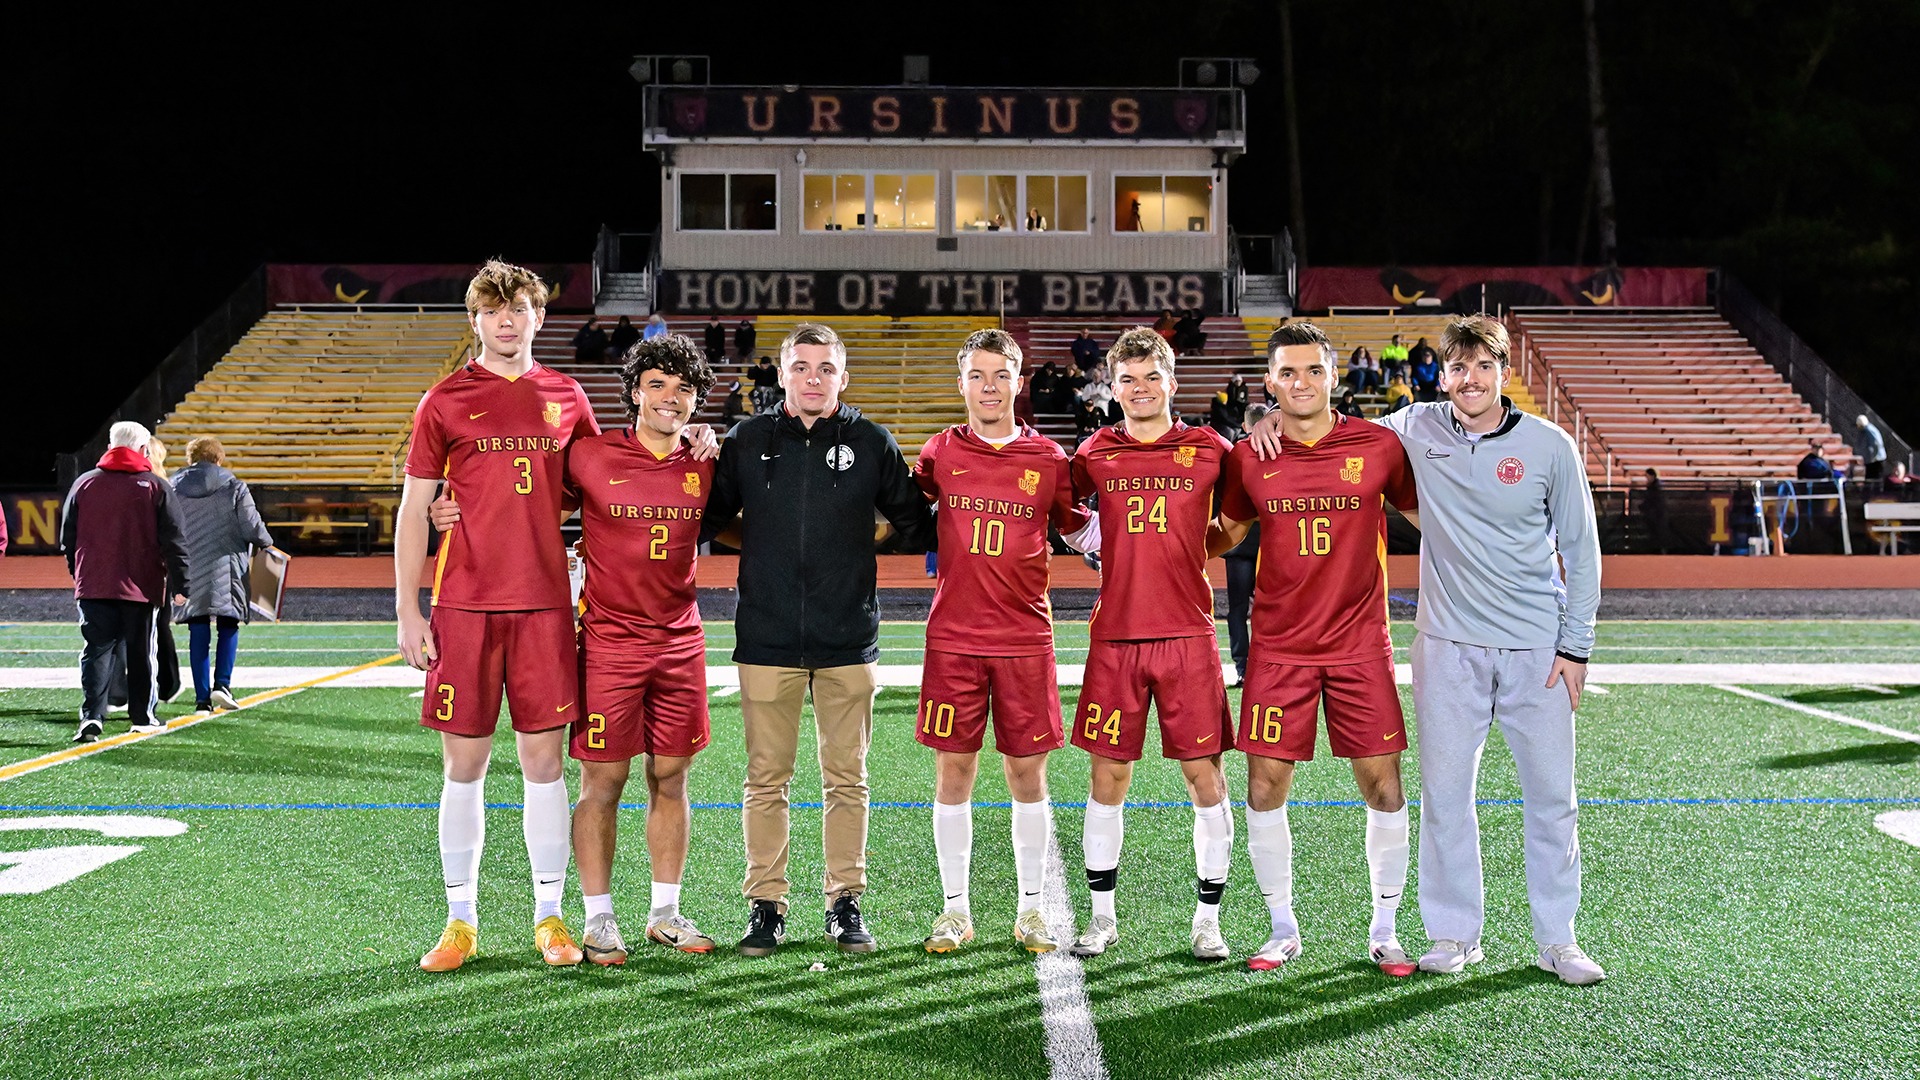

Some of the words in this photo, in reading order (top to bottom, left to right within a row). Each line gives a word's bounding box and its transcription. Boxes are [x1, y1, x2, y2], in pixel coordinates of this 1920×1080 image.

[743, 97, 1140, 133] URSINUS
[677, 274, 816, 310] HOME
[837, 274, 898, 310] OF
[920, 275, 1019, 312] THE
[1042, 275, 1204, 312] BEARS
[475, 436, 562, 453] URSINUS
[512, 455, 534, 496] 3
[1105, 476, 1195, 493] URSINUS
[608, 503, 703, 521] URSINUS
[948, 495, 1036, 519] URSINUS
[1125, 494, 1168, 535] 24
[1266, 495, 1361, 514] URSINUS
[648, 523, 670, 561] 2
[968, 516, 1006, 558] 10
[1297, 516, 1332, 557] 16
[435, 682, 456, 722] 3
[921, 698, 957, 740] 10
[586, 712, 607, 750] 2
[1083, 701, 1123, 747] 24
[1248, 702, 1284, 745] 16
